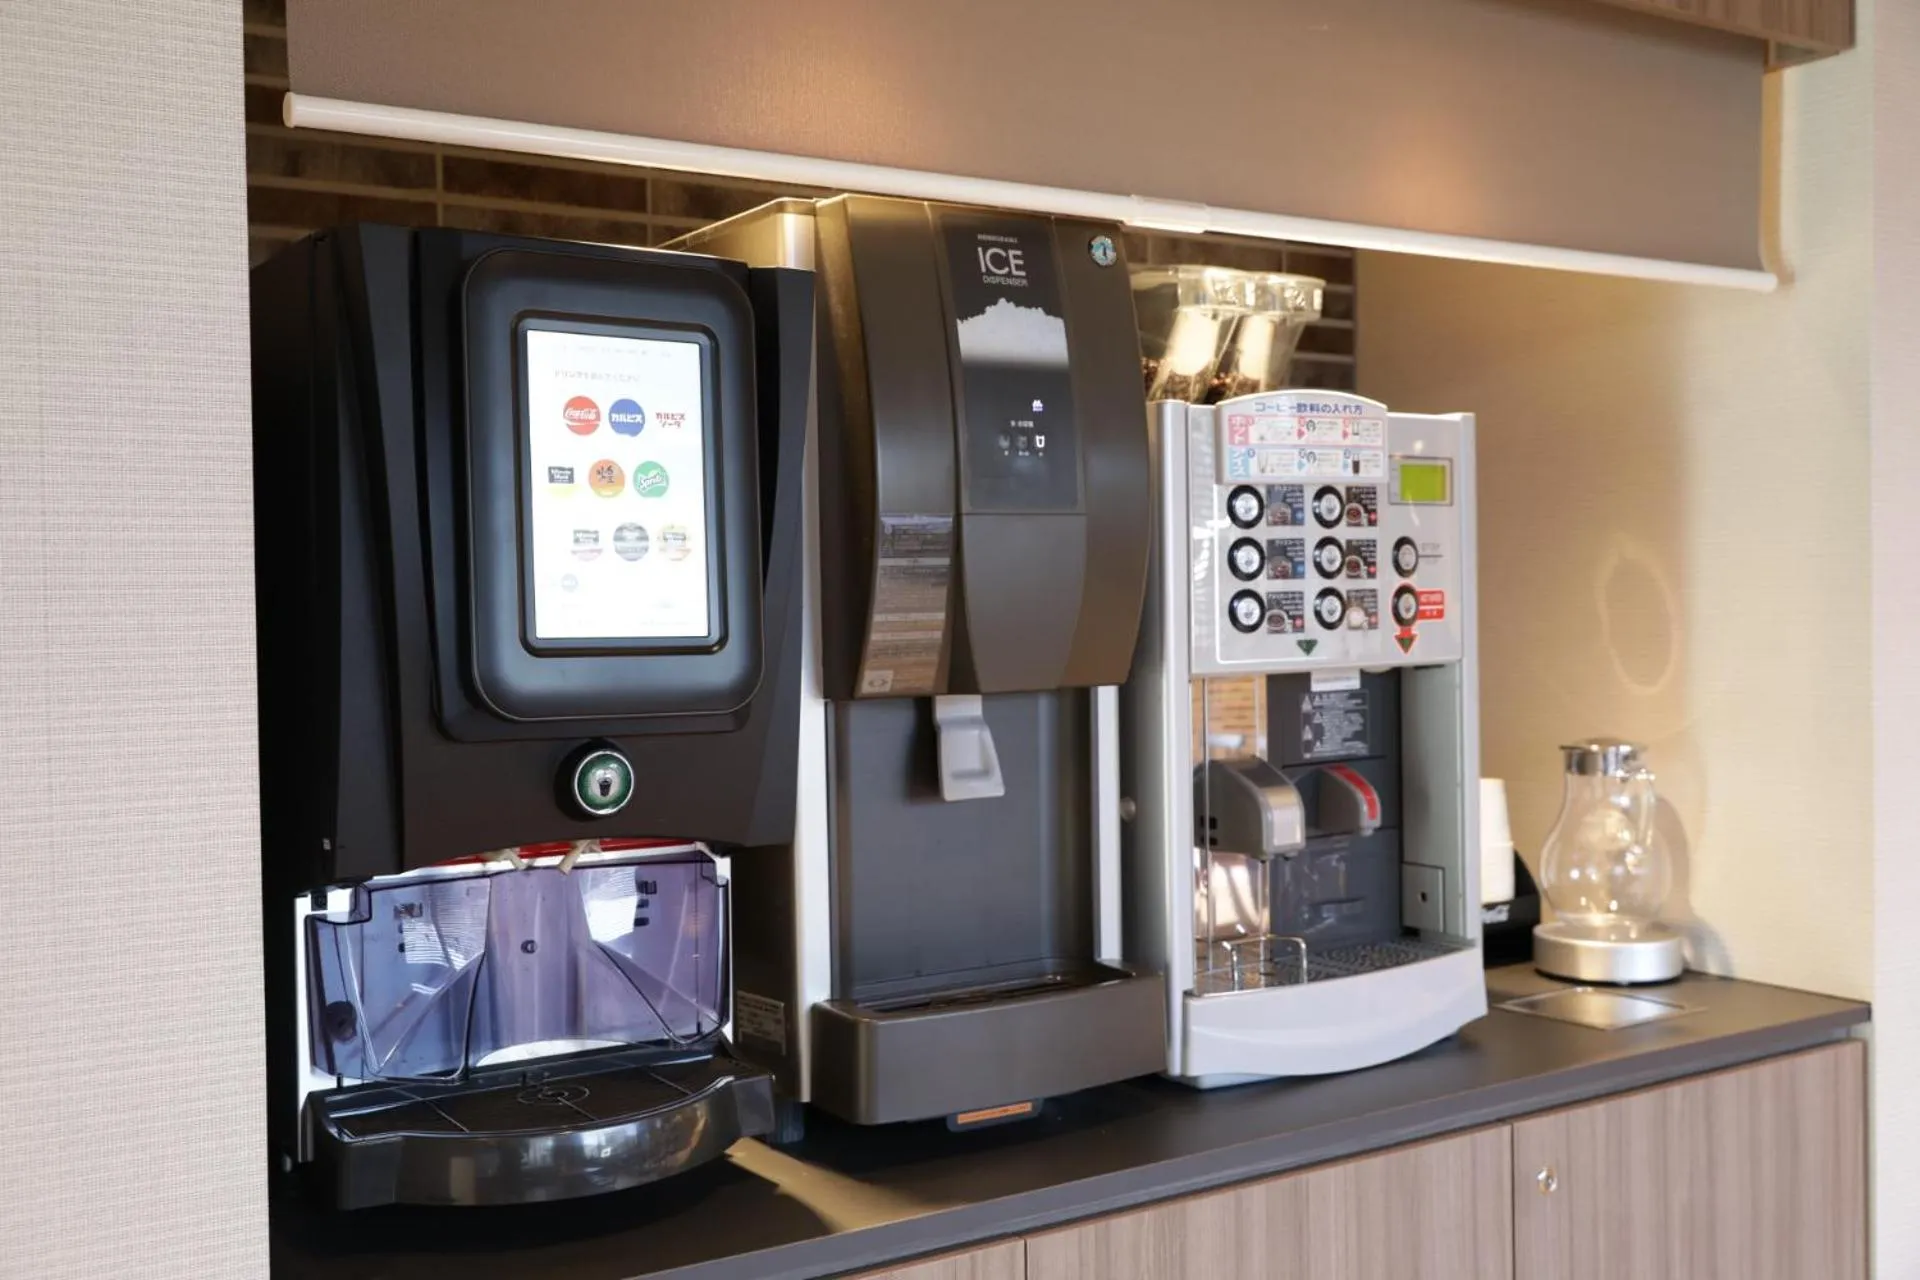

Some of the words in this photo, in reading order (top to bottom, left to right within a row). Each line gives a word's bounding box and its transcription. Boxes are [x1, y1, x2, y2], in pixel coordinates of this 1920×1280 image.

[977, 246, 1027, 276] ICE
[982, 275, 1029, 287] DISPENSER
[1254, 401, 1363, 415] コーヒー飲料の入れ方
[610, 412, 643, 424] カルピス
